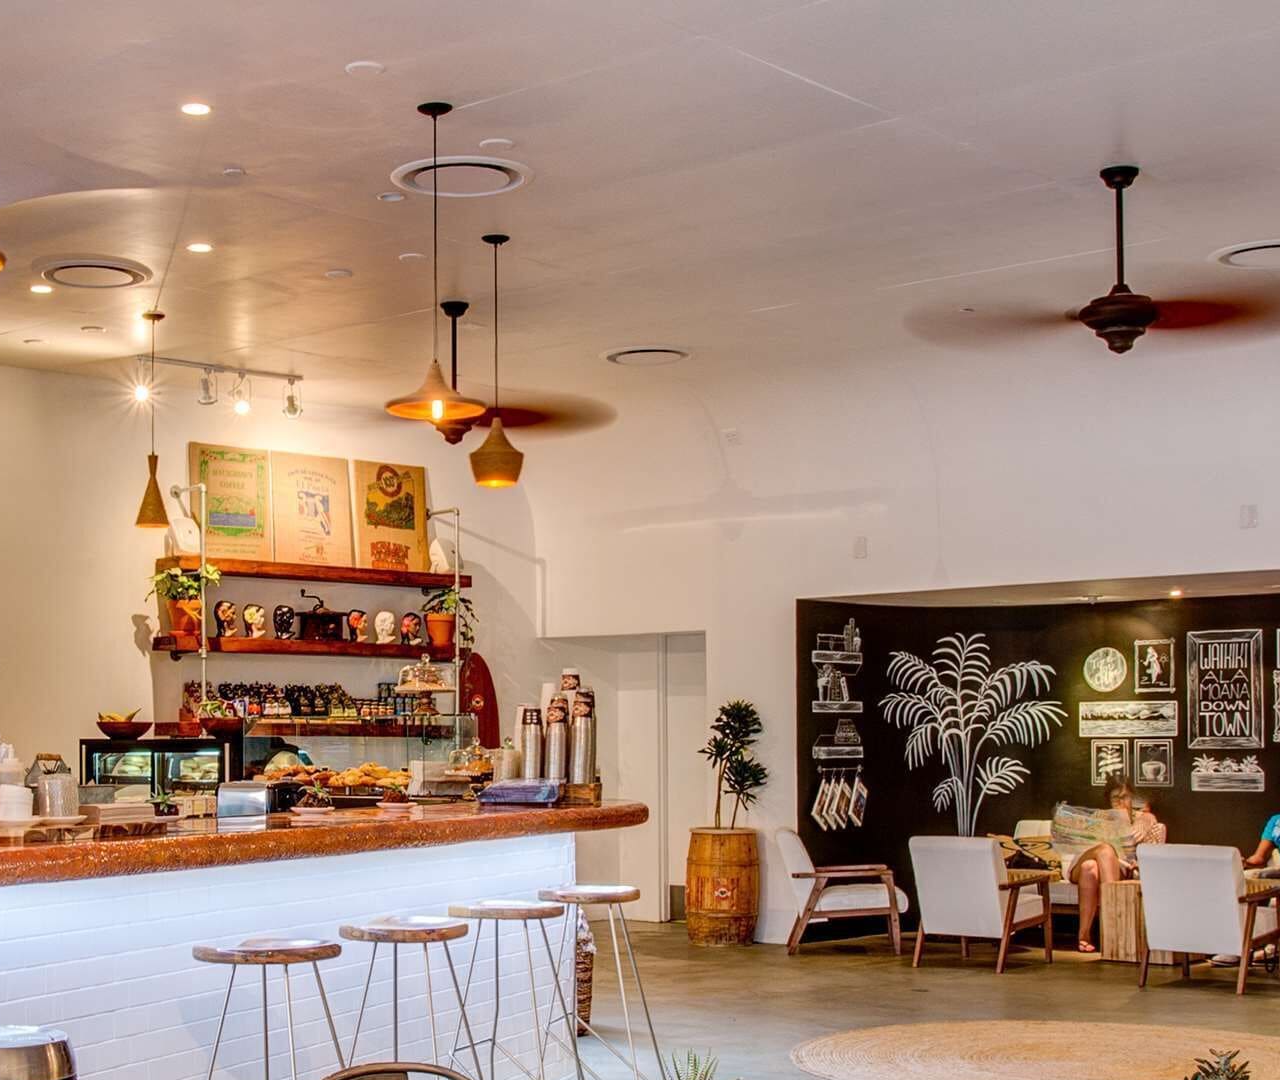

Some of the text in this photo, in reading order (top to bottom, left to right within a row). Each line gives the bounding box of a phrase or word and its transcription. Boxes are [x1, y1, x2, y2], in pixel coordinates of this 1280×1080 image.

[1199, 643, 1249, 670] WAIKIKI
[1204, 669, 1249, 683] ALA
[1200, 683, 1250, 700] MOANA
[1200, 700, 1250, 711] DOWN
[1200, 711, 1250, 736] TOWN
